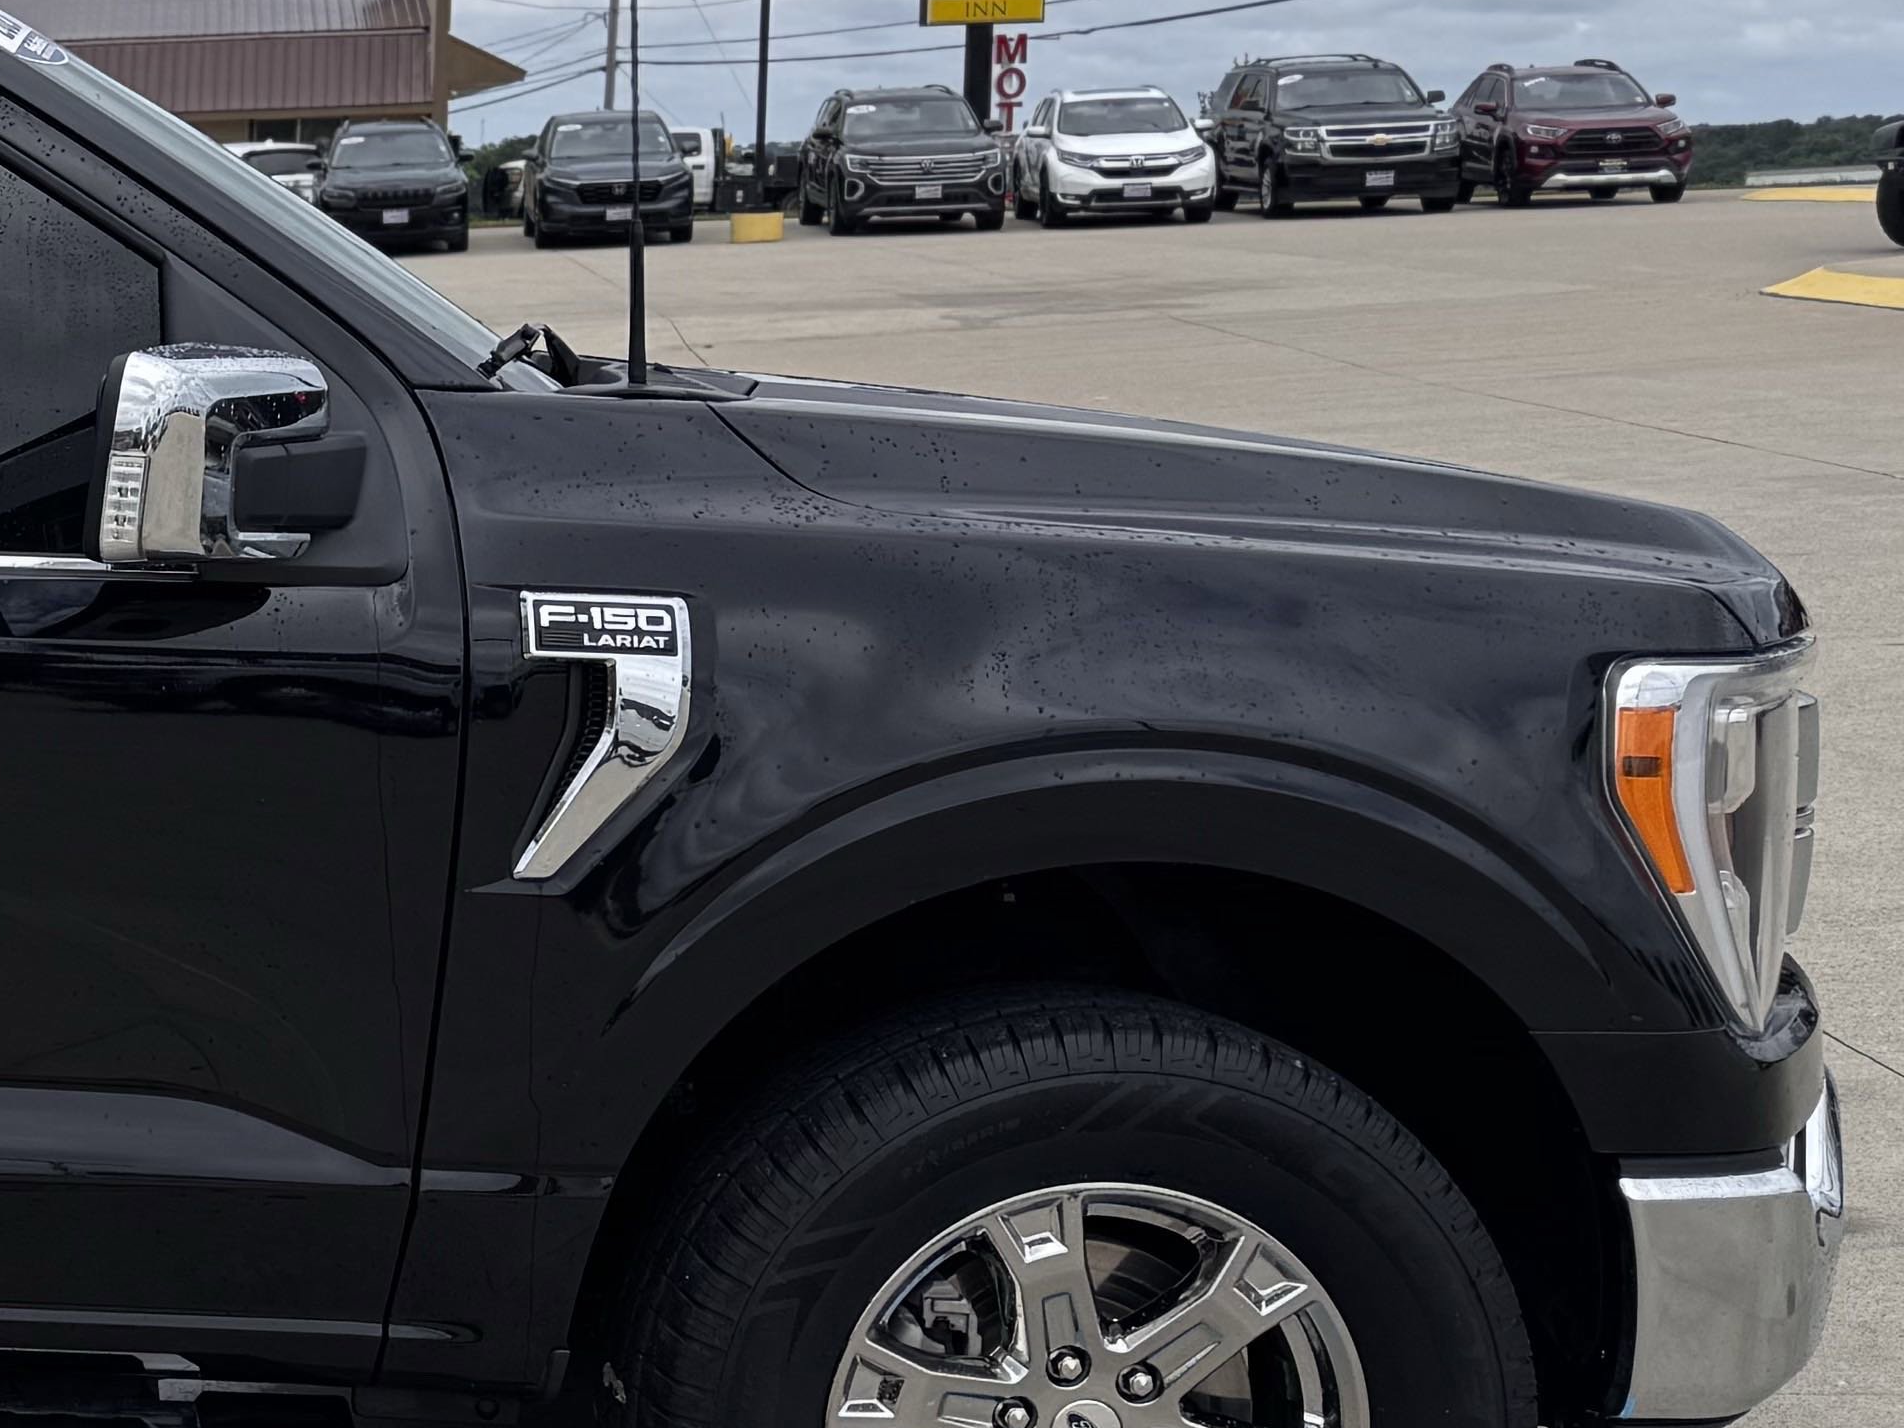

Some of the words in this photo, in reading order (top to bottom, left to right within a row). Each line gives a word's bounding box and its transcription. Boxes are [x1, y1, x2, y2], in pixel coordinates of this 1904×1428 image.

[965, 0, 1007, 18] INN
[539, 604, 672, 632] F-150
[583, 633, 669, 649] LARIAT
